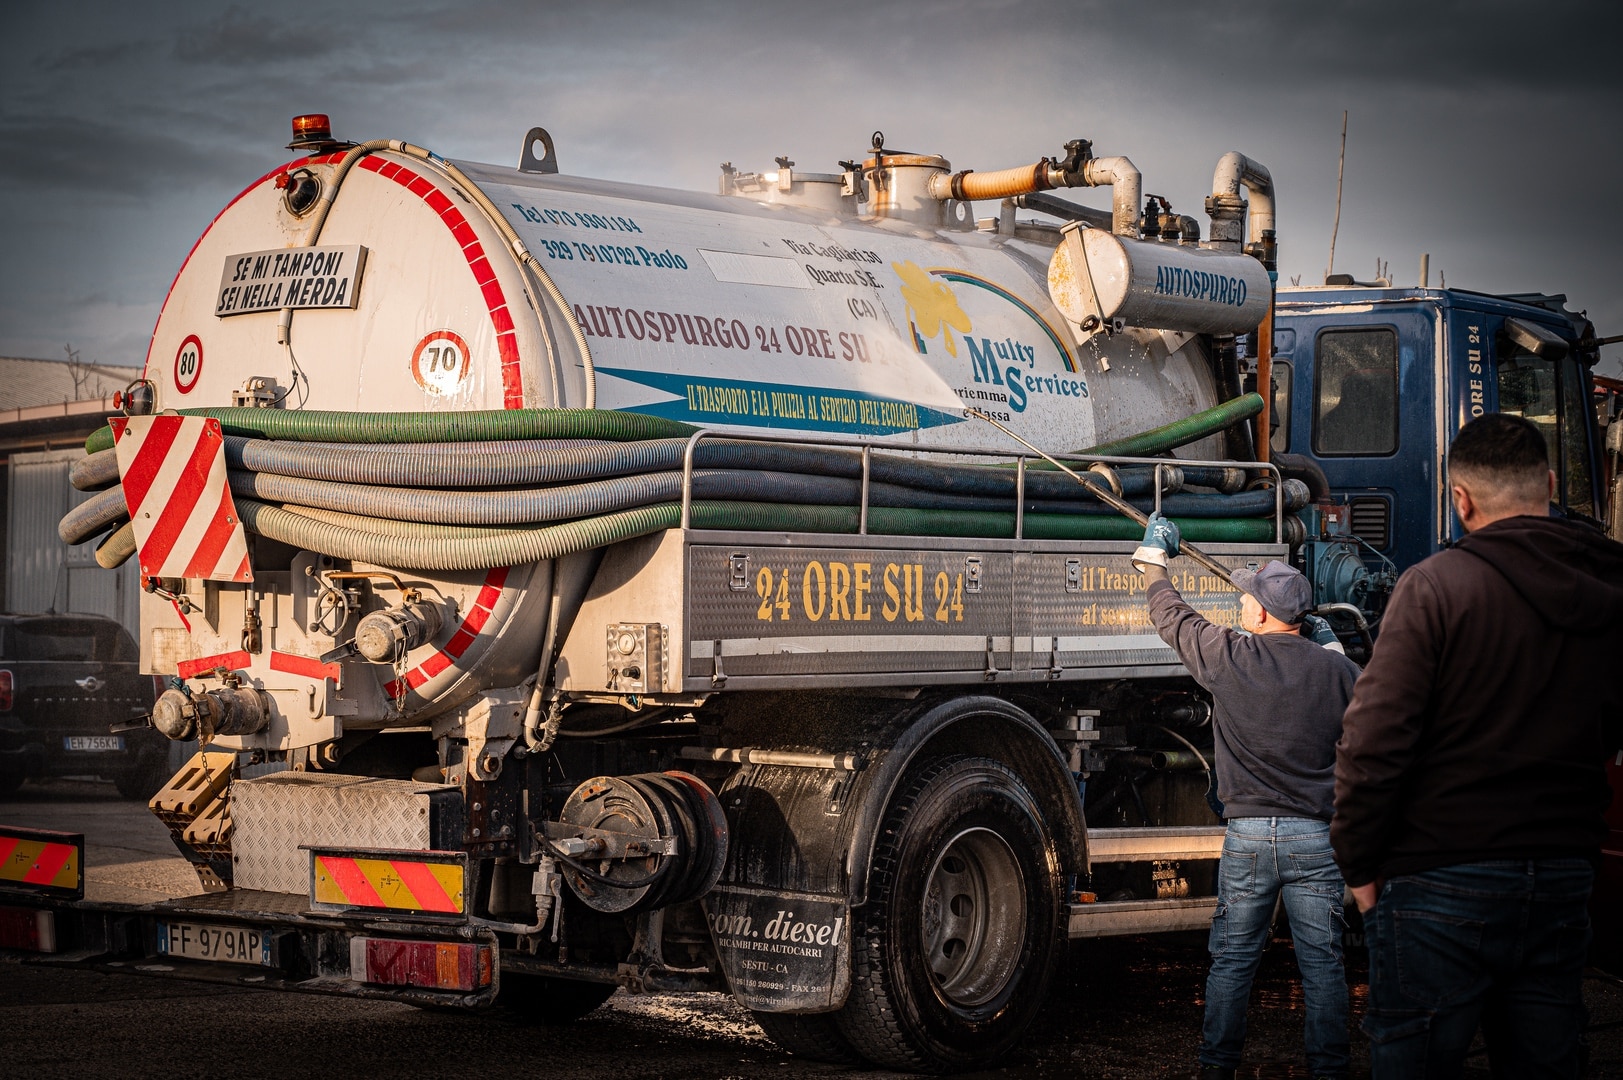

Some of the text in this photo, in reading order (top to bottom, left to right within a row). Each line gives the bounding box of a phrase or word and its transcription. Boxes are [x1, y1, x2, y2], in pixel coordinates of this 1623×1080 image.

[511, 203, 644, 233] Tel 070 8801184
[540, 239, 688, 270] 329 7910722 Paolo
[781, 238, 813, 255] Via
[232, 251, 344, 282] SE MI TAMPONI
[805, 264, 858, 286] Quartu
[217, 277, 348, 312] SEI NELLA MERDA
[1154, 265, 1247, 307] AUTOSPURGO
[846, 297, 878, 320] (CA)
[573, 303, 751, 351] AUTOSPURGO
[754, 324, 782, 354] 24
[784, 324, 835, 360] ORE
[838, 330, 872, 364] SU
[180, 351, 196, 375] 80
[428, 346, 456, 373] 70
[963, 335, 1034, 386] Multy
[1468, 325, 1484, 418] ORE SU 24
[686, 384, 698, 411] IL
[697, 385, 749, 415] TRASPORTO
[751, 390, 758, 416] E
[757, 391, 770, 417] LA
[771, 391, 806, 419] PULIZIA
[808, 395, 819, 420] AL
[820, 396, 858, 424] SERVIZIO
[1006, 366, 1089, 413] Services
[756, 560, 965, 624] 24 ORE SU 24
[1082, 567, 1095, 591] il
[1097, 567, 1146, 596] Traspo
[1183, 570, 1195, 592] la
[1082, 603, 1097, 625] al
[764, 910, 843, 947] diesel
[719, 937, 822, 958] RICAMBI PER AUTOCARRI
[742, 959, 769, 972] SESTU
[775, 964, 789, 974] CA
[791, 984, 809, 993] FAX
